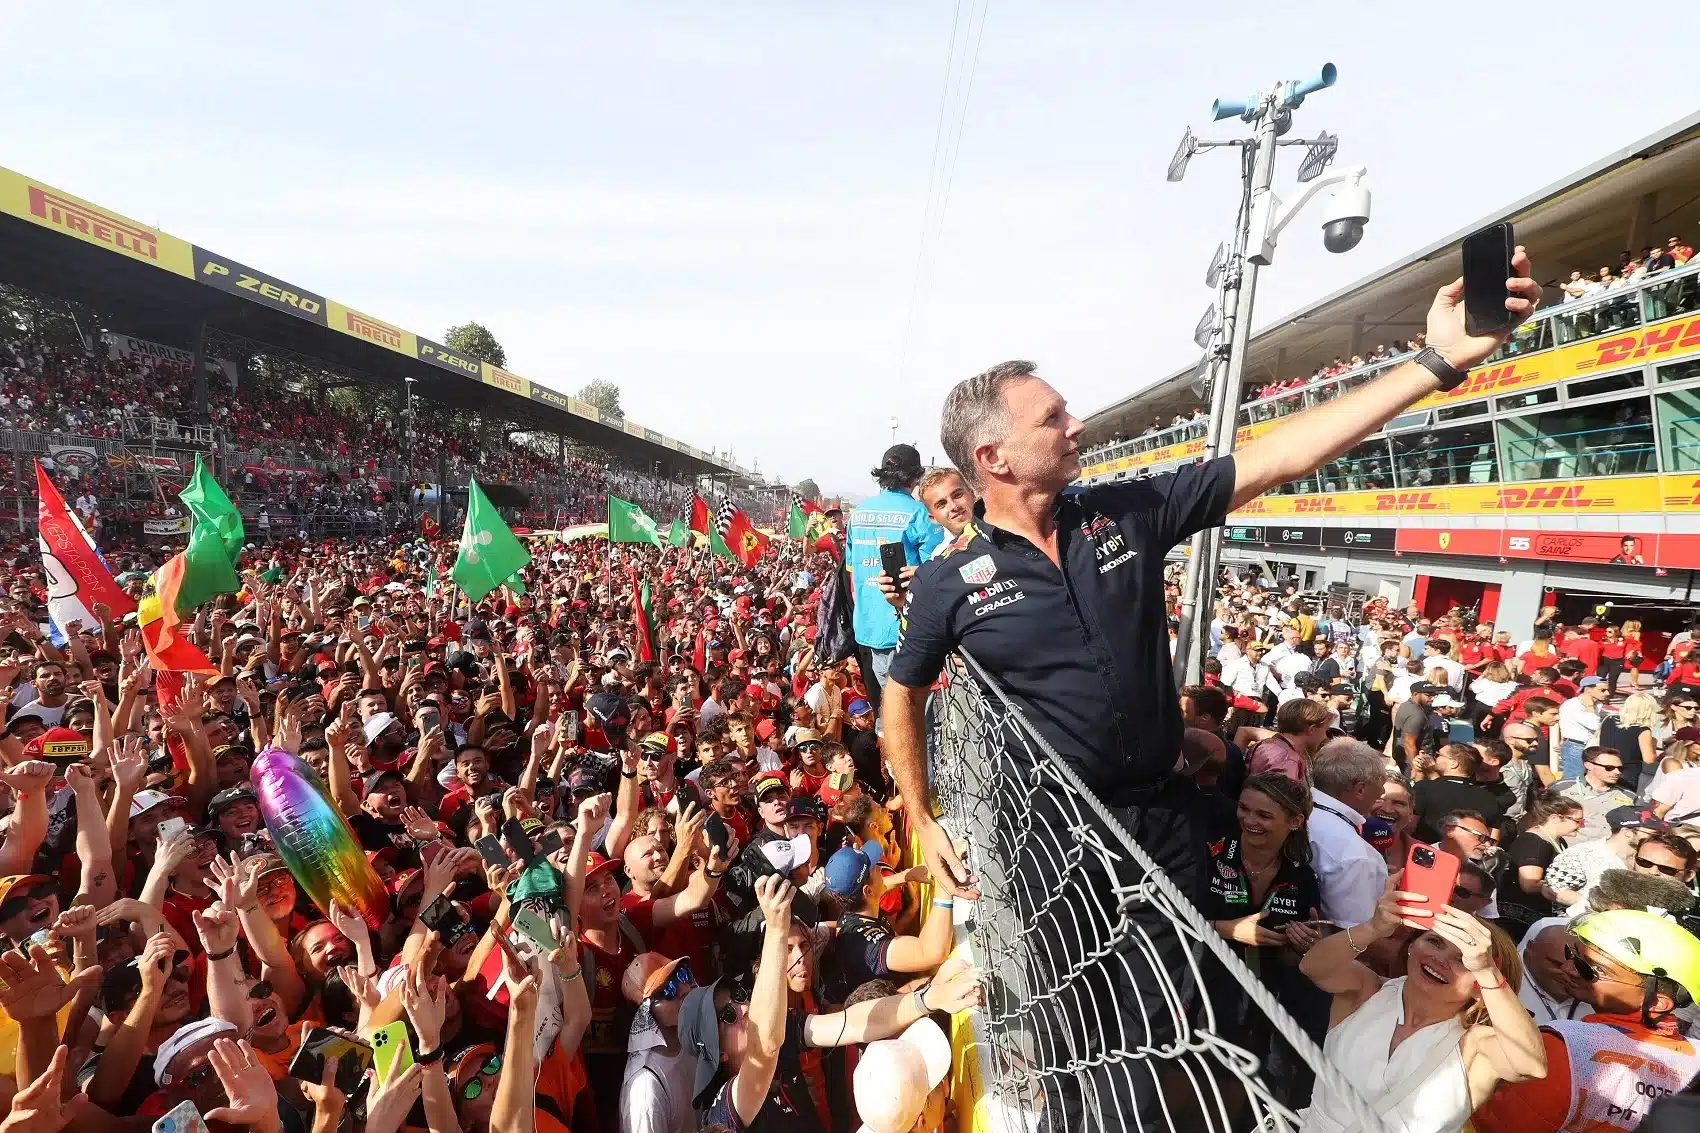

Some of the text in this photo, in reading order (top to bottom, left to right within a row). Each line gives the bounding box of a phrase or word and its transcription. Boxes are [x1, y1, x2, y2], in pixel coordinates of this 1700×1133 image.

[28, 185, 157, 260] PIRELLI
[203, 262, 320, 314] P ZERO
[347, 312, 401, 348] PIRELLI
[127, 340, 193, 363] CHARLES
[421, 345, 479, 374] P ZERO
[492, 369, 522, 392] PIRELLI
[532, 387, 566, 406] P ZERO
[605, 416, 622, 427] ZERO
[1294, 498, 1336, 512] DHL
[1376, 493, 1437, 510] DHL
[1496, 486, 1592, 508] DHL
[876, 513, 906, 524] SEVEN
[1096, 535, 1124, 560] BYBIT
[1508, 537, 1530, 551] 55
[1540, 546, 1572, 555] SAINZ
[1542, 537, 1584, 547] CARLOS
[43, 518, 102, 592] VERSTAPPEN
[1099, 550, 1137, 574] HONDA
[967, 582, 1004, 605] Mobil
[975, 591, 1026, 616] ORACLE
[1375, 829, 1388, 837] sky
[1227, 839, 1238, 859] zoom
[1606, 1103, 1637, 1121] PIT
